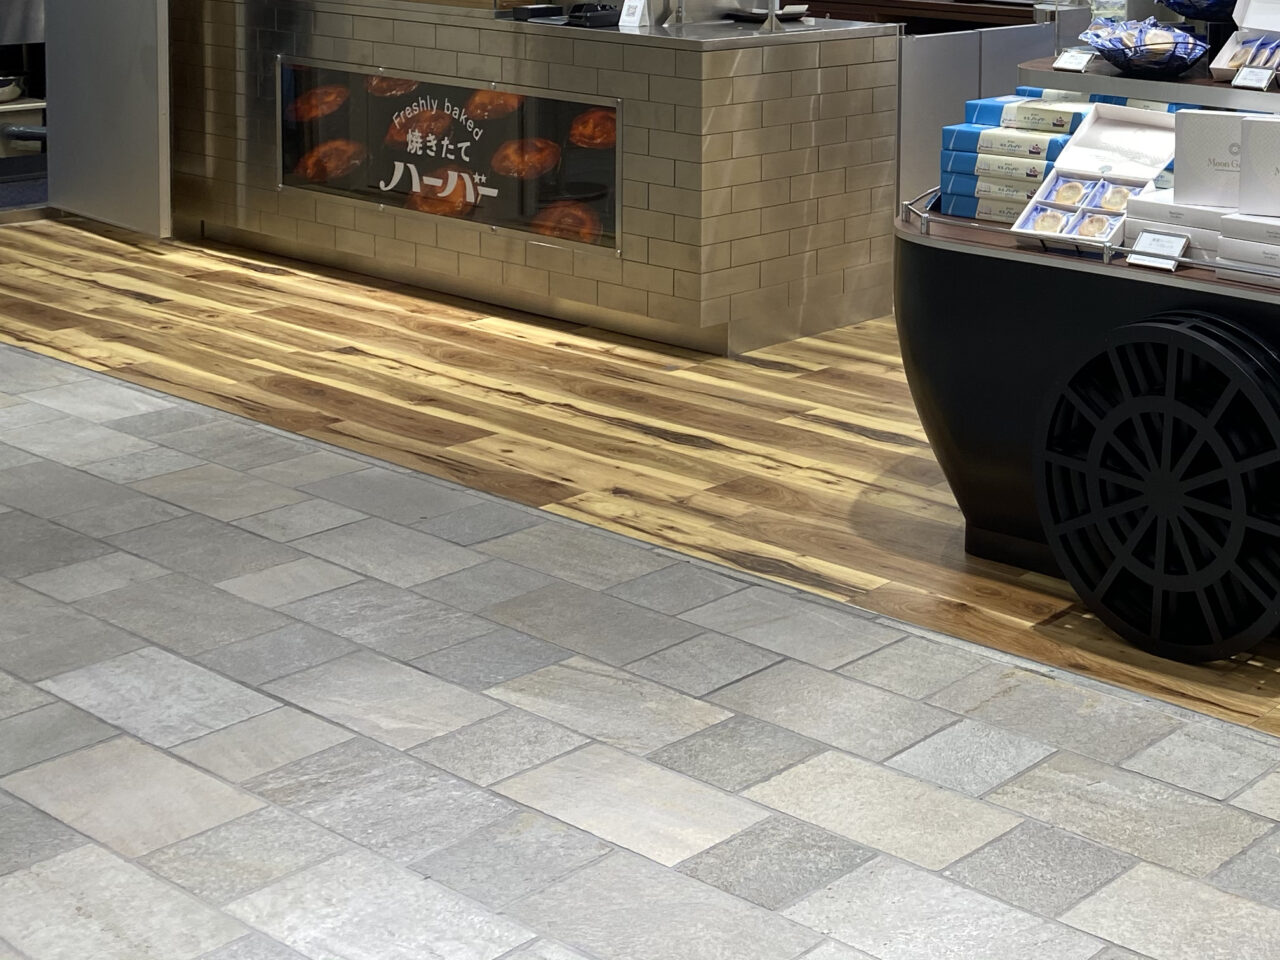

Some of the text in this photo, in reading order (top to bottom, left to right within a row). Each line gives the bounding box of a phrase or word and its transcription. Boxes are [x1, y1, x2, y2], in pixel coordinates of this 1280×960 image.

[392, 95, 484, 141] Freshly baked
[406, 128, 471, 162] 焼きたて
[1207, 157, 1231, 169] Moon
[379, 161, 499, 204] ハーバー
